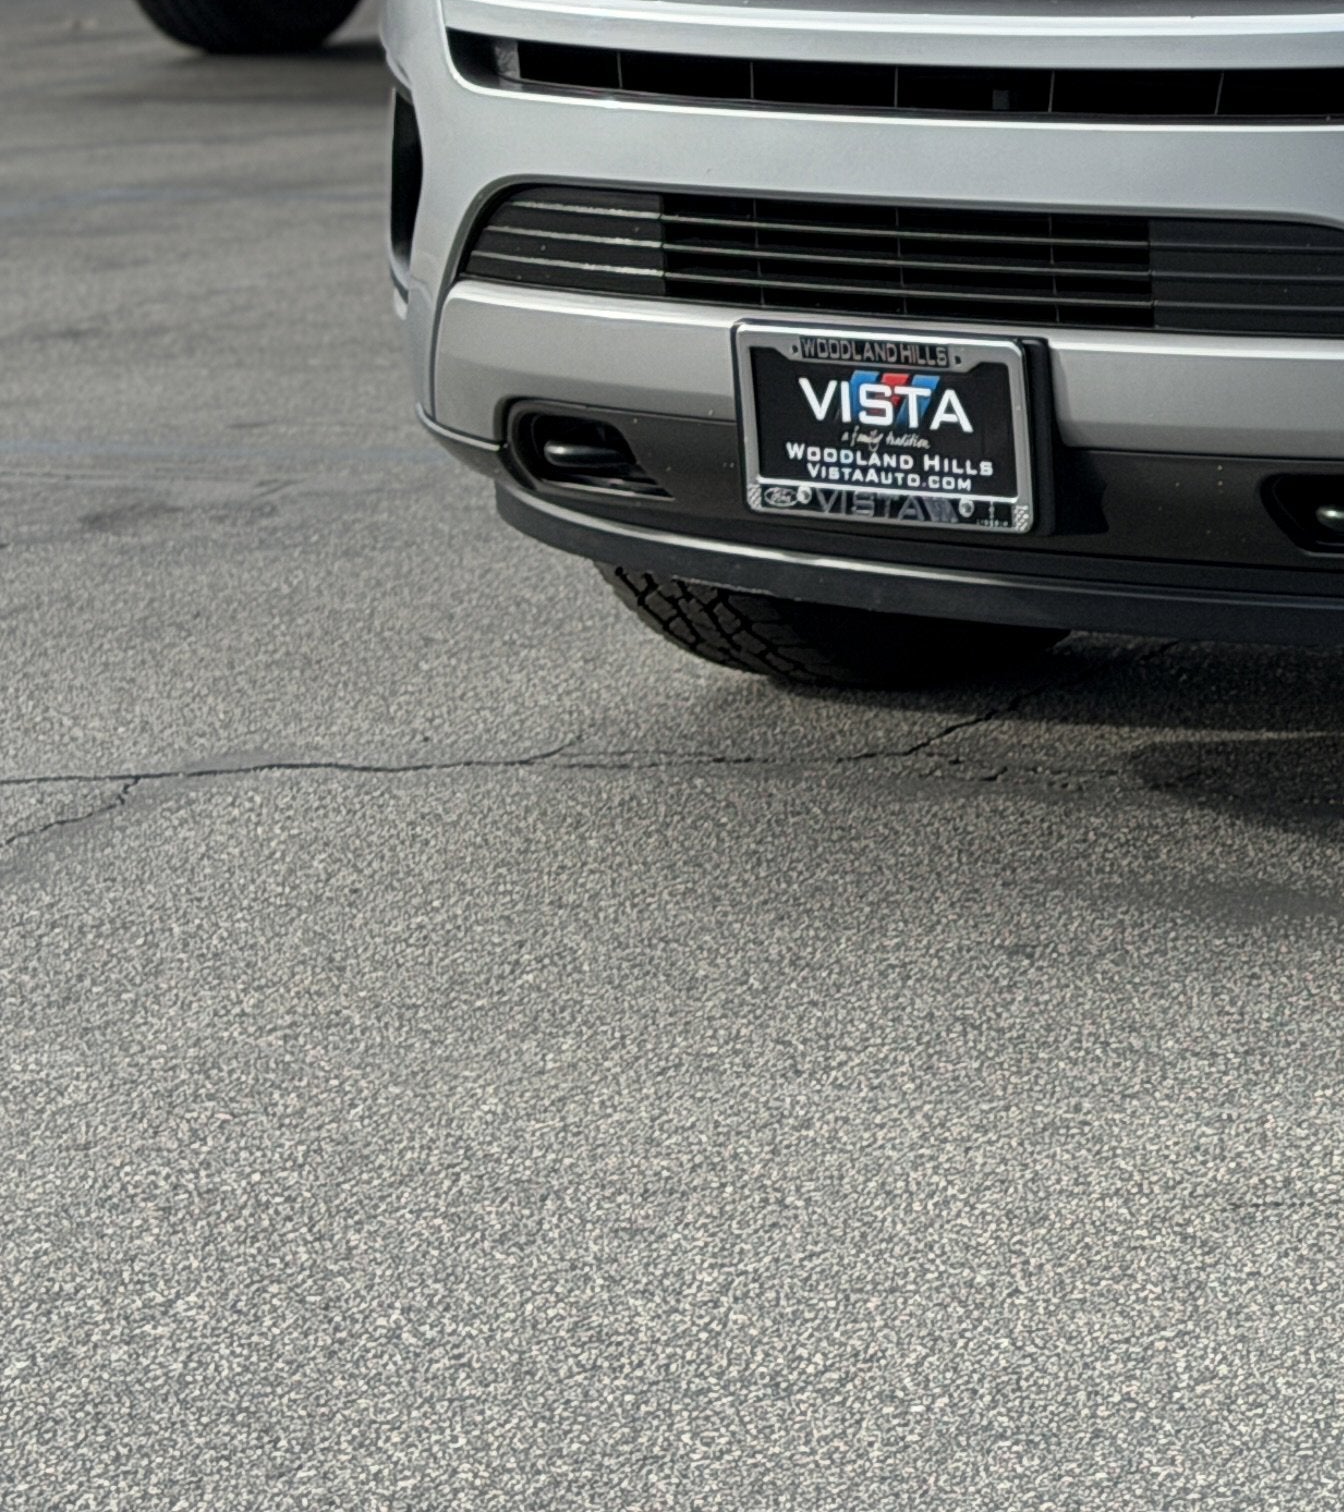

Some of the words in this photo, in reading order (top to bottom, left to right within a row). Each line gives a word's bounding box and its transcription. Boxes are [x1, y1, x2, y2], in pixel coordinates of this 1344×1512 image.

[802, 338, 897, 364] WOODLAND
[899, 343, 947, 367] HILLS
[798, 376, 974, 434] VISTA
[815, 487, 925, 522] VISTA
